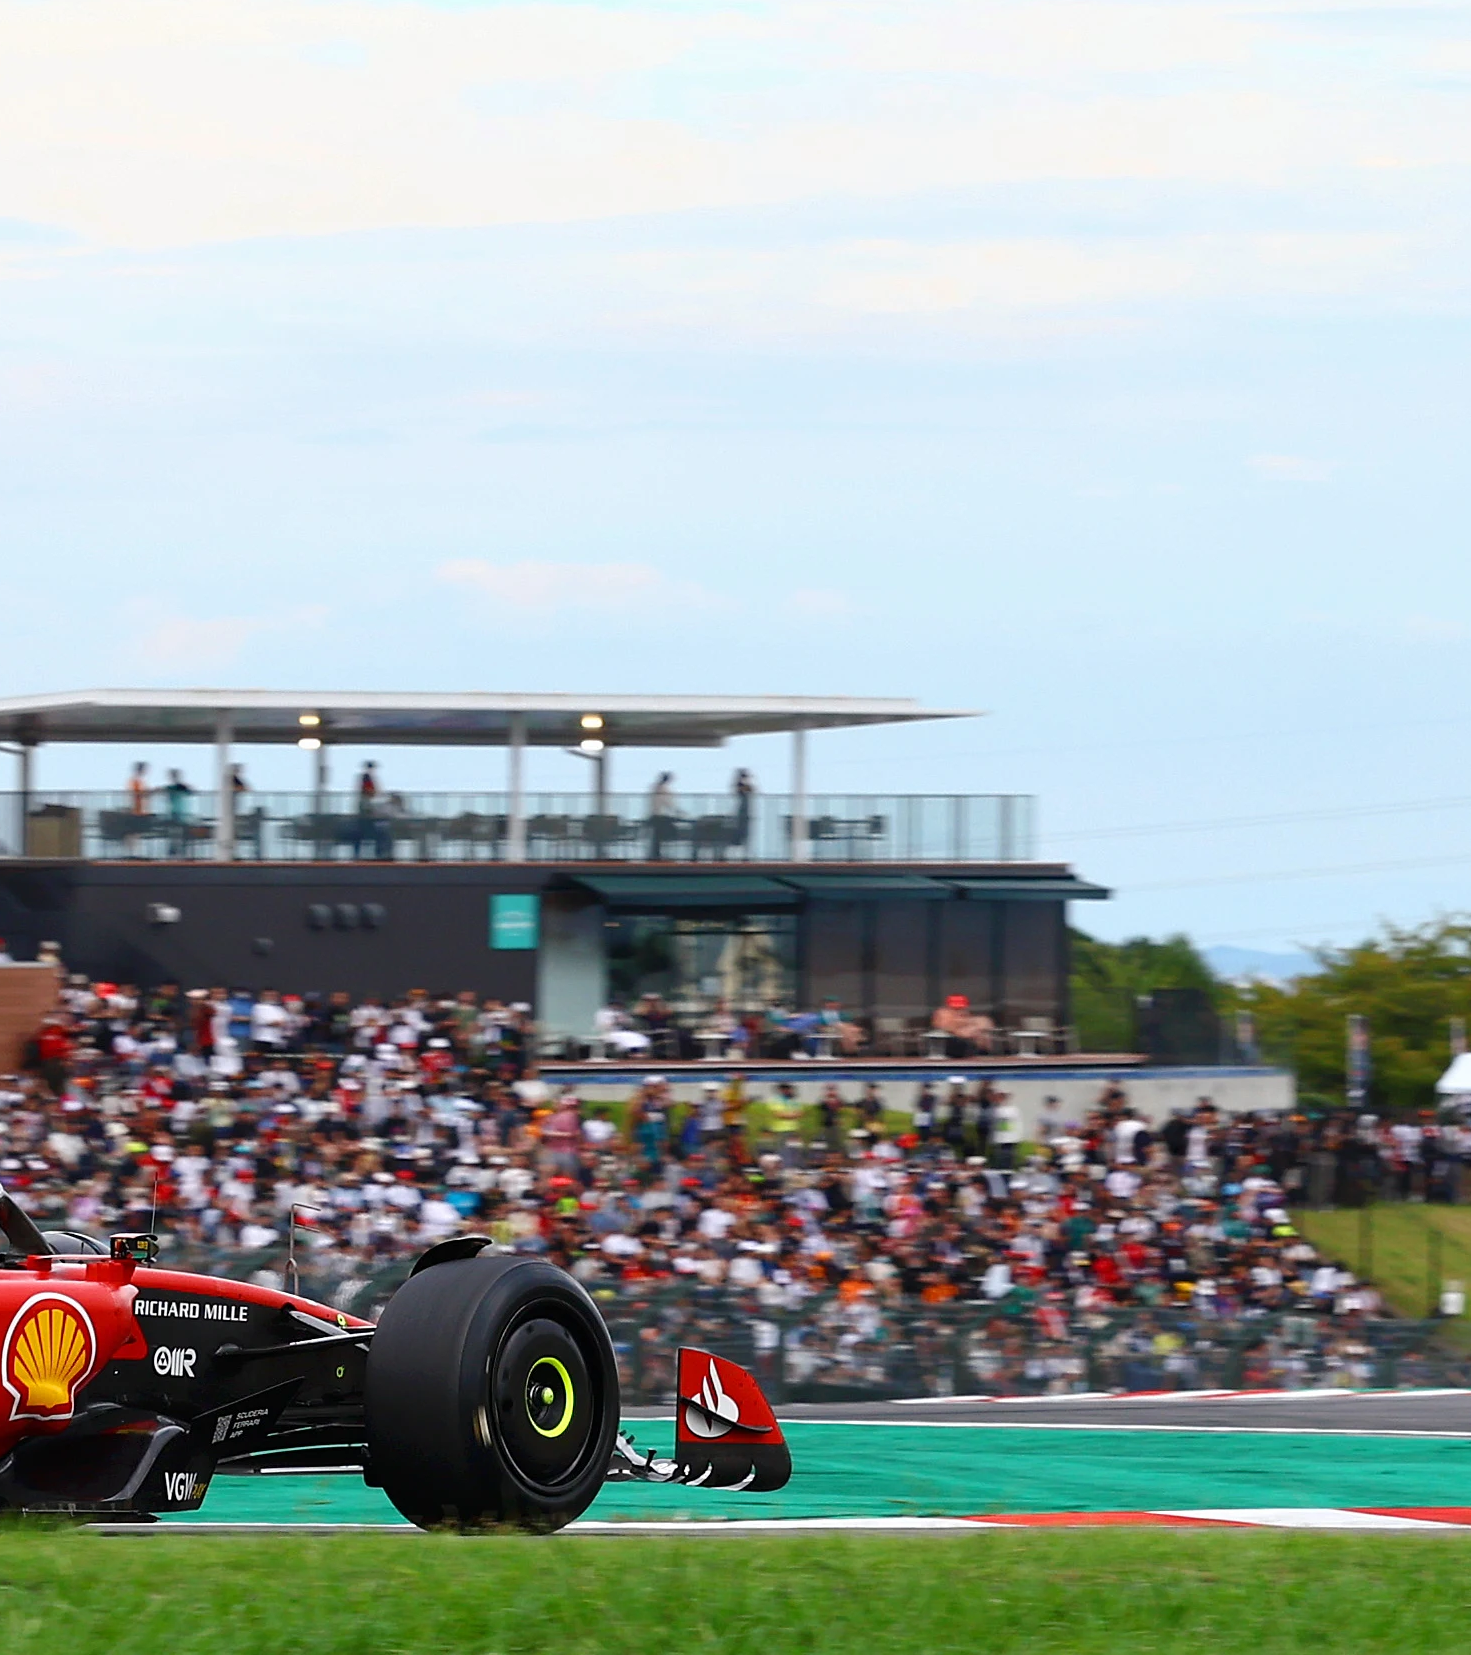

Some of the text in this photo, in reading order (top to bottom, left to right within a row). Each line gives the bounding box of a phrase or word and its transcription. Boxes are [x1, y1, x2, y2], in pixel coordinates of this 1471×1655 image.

[134, 1299, 248, 1322] RICHARD MILLE
[236, 1408, 269, 1420] SCUDERIA
[233, 1418, 261, 1429] FERRARI
[229, 1430, 244, 1439] APP
[164, 1472, 198, 1501] VGW
